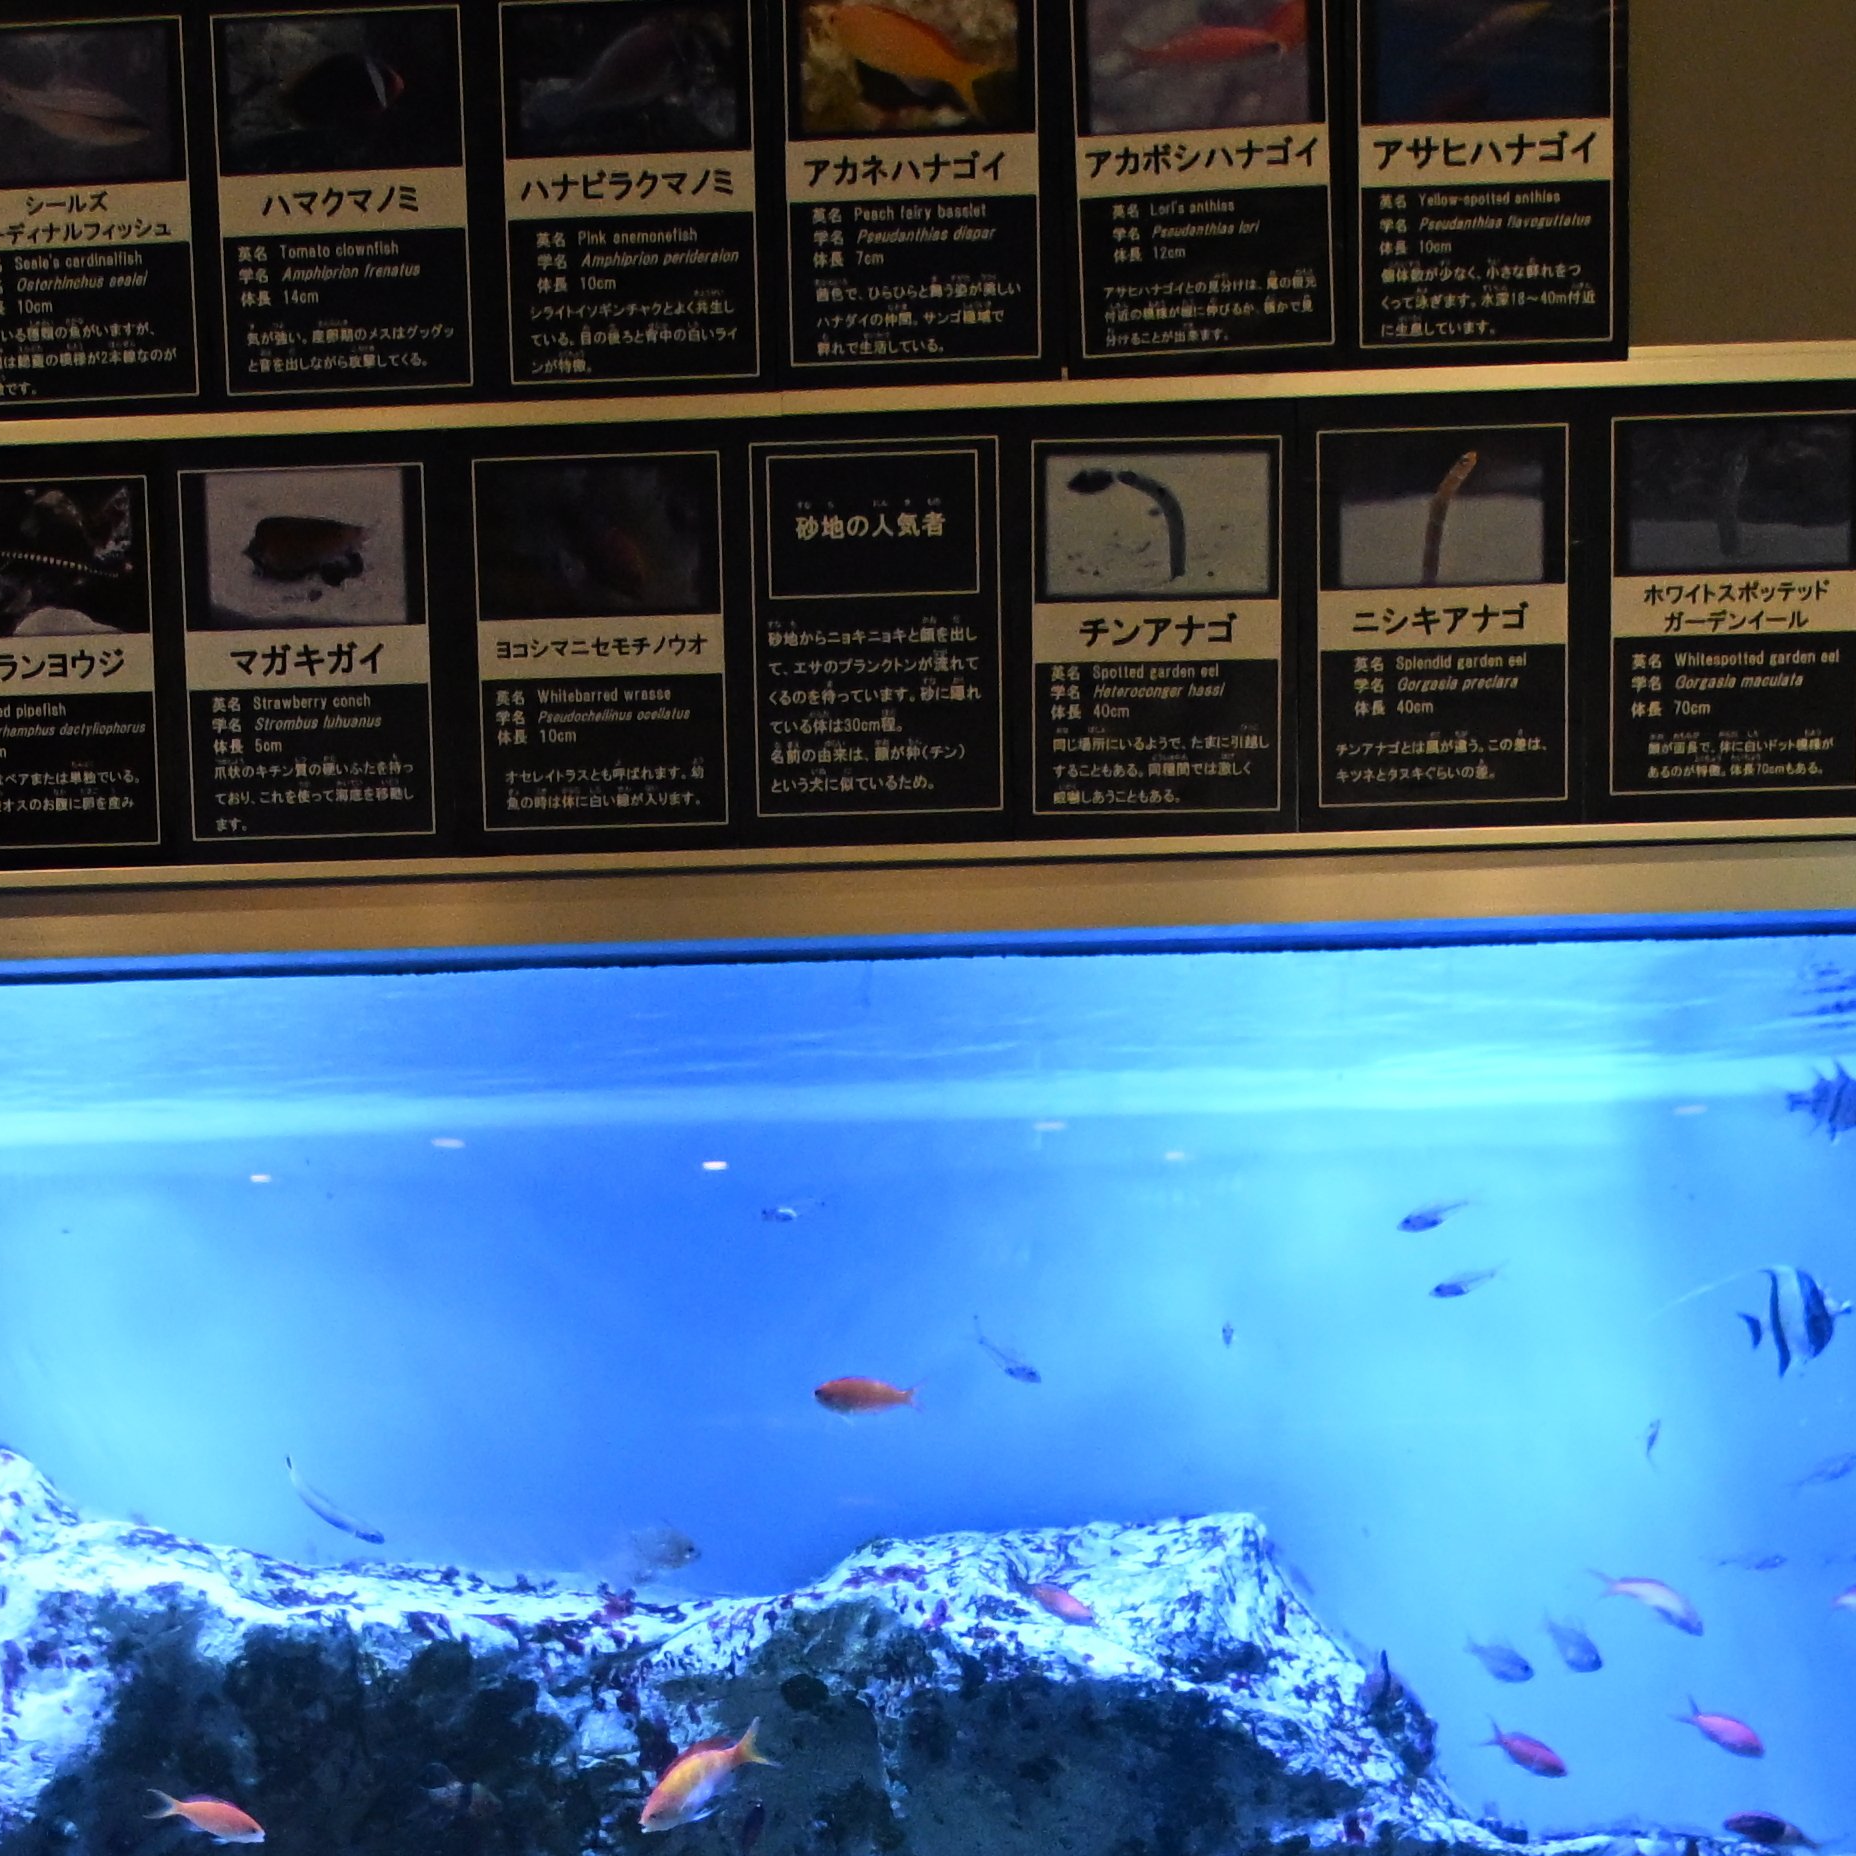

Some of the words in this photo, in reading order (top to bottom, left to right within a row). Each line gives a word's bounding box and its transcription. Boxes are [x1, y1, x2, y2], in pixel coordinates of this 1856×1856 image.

[1085, 134, 1318, 178] アカボシハナゴイ
[1373, 130, 1596, 170] アサヒハナゴイ
[804, 149, 1005, 188] アカネハナゴイ
[520, 165, 732, 203] ハナビラクマノミ
[25, 191, 108, 214] シールズ
[261, 184, 418, 219] ハマクマノミ
[1112, 203, 1139, 220] 英名
[1150, 200, 1184, 216] Lori's
[1189, 198, 1235, 214] anthias
[1379, 194, 1407, 210] 英名
[1515, 189, 1560, 204] anthias
[812, 207, 841, 224] 英名
[854, 205, 894, 222] Peach
[900, 203, 931, 222] fairy
[937, 202, 986, 219] basslet
[536, 231, 566, 248] 英名
[577, 230, 606, 246] Pink
[612, 226, 698, 245] anemonefish
[1379, 240, 1407, 256] 体長
[1419, 239, 1451, 254] 10cm
[65, 250, 142, 268] cardinalfish
[237, 245, 267, 262] 英名
[280, 242, 330, 260] Tomato
[335, 239, 399, 257] clownfish
[238, 267, 268, 285] 学名
[281, 264, 358, 282] Amphiprion
[363, 261, 420, 279] frenatus
[795, 511, 946, 542] 砂地の人気者
[1644, 578, 1829, 606] ホワイトスポッテッド
[1353, 601, 1528, 637] ニシキアナゴ
[1664, 607, 1808, 633] ガーデンイール
[1079, 612, 1237, 649] チンアナゴ
[496, 633, 707, 661] ヨコシマニセモチノウオ
[230, 641, 384, 678] マガキガイ
[1353, 656, 1383, 673] 英名
[1395, 654, 1452, 671] Splendid
[1457, 653, 1503, 670] garden
[1508, 653, 1527, 667] eel
[1632, 652, 1661, 670] 英名
[1674, 649, 1764, 668] Whitespotted
[1769, 649, 1816, 666] garden
[1821, 649, 1839, 663] eel
[1050, 665, 1080, 681] 英名
[1092, 664, 1144, 680] Spotted
[1150, 664, 1194, 680] garden
[1200, 663, 1218, 677] eel
[211, 696, 241, 713] 英名
[253, 694, 326, 712] Strawberry
[332, 692, 371, 708] conch
[495, 689, 525, 706] 英名
[537, 687, 618, 704] Whitebarred
[623, 686, 671, 701] wrasse
[15, 701, 66, 719] pipefish
[1050, 704, 1081, 720] 体長
[1092, 702, 1129, 718] 40cm
[1354, 699, 1385, 716] 体長
[1396, 699, 1433, 714] 40cm
[212, 717, 242, 733] 学名
[254, 715, 318, 731] Strombus
[322, 713, 382, 729] luhuanus
